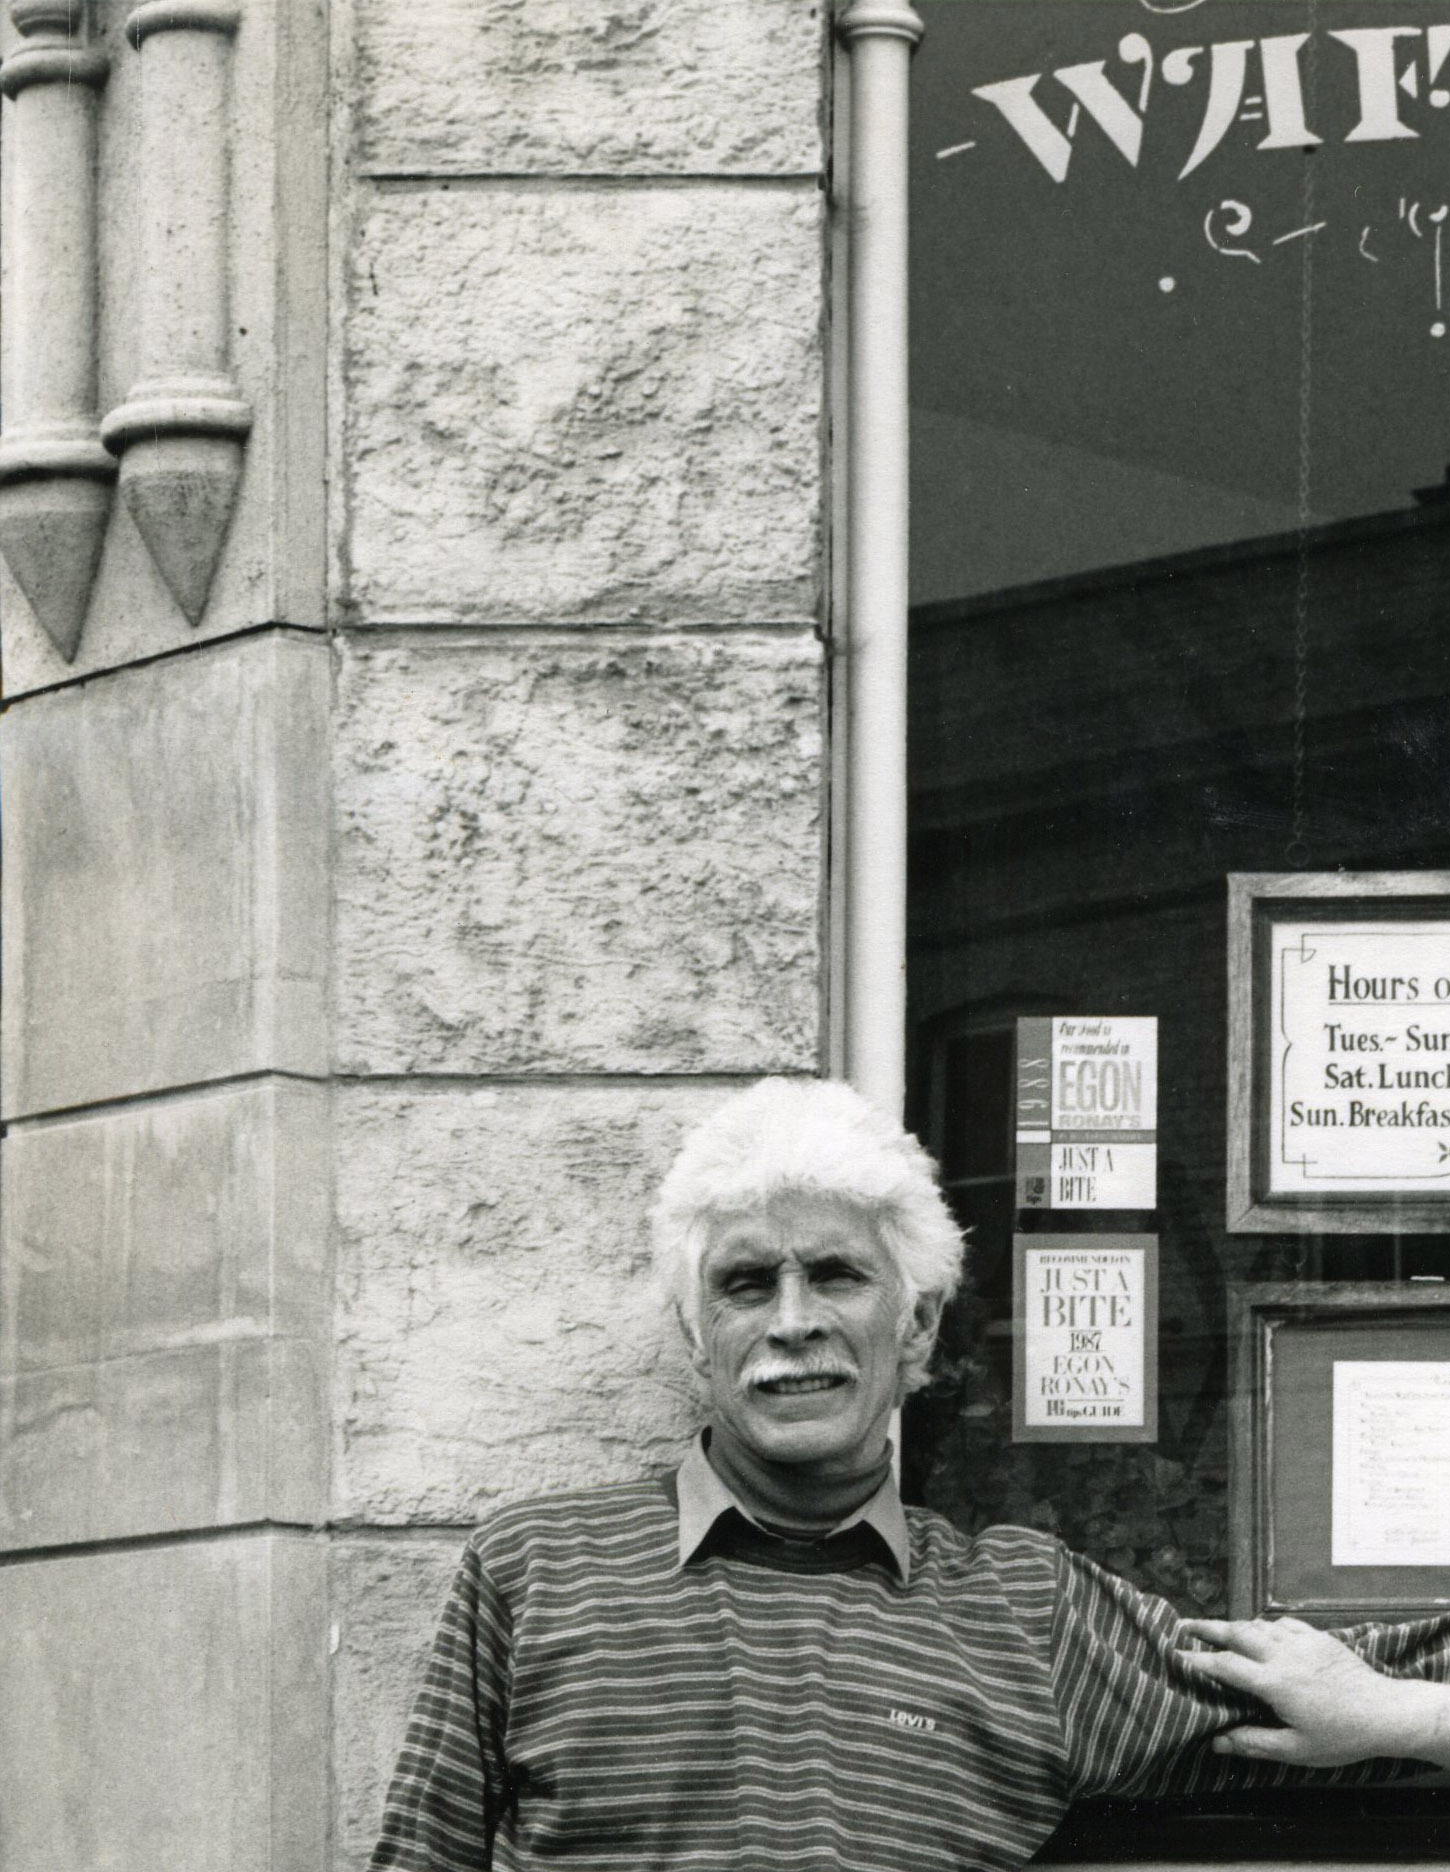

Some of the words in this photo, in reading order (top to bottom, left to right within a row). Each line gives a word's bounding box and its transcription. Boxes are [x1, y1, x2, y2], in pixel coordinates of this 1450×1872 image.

[1328, 965, 1419, 1000] Hours
[1059, 1060, 1142, 1112] EGON
[1058, 1114, 1142, 1128] RONAY'S
[1059, 1147, 1099, 1172] JUST
[1103, 1148, 1114, 1172] A
[1060, 1177, 1096, 1202] BITE
[1041, 1268, 1107, 1292] JUST
[1111, 1269, 1129, 1291] A
[1043, 1295, 1131, 1327] BITE
[1070, 1331, 1102, 1352] 1987
[1053, 1354, 1114, 1375] EGON
[1041, 1376, 1130, 1396] RONAY'S
